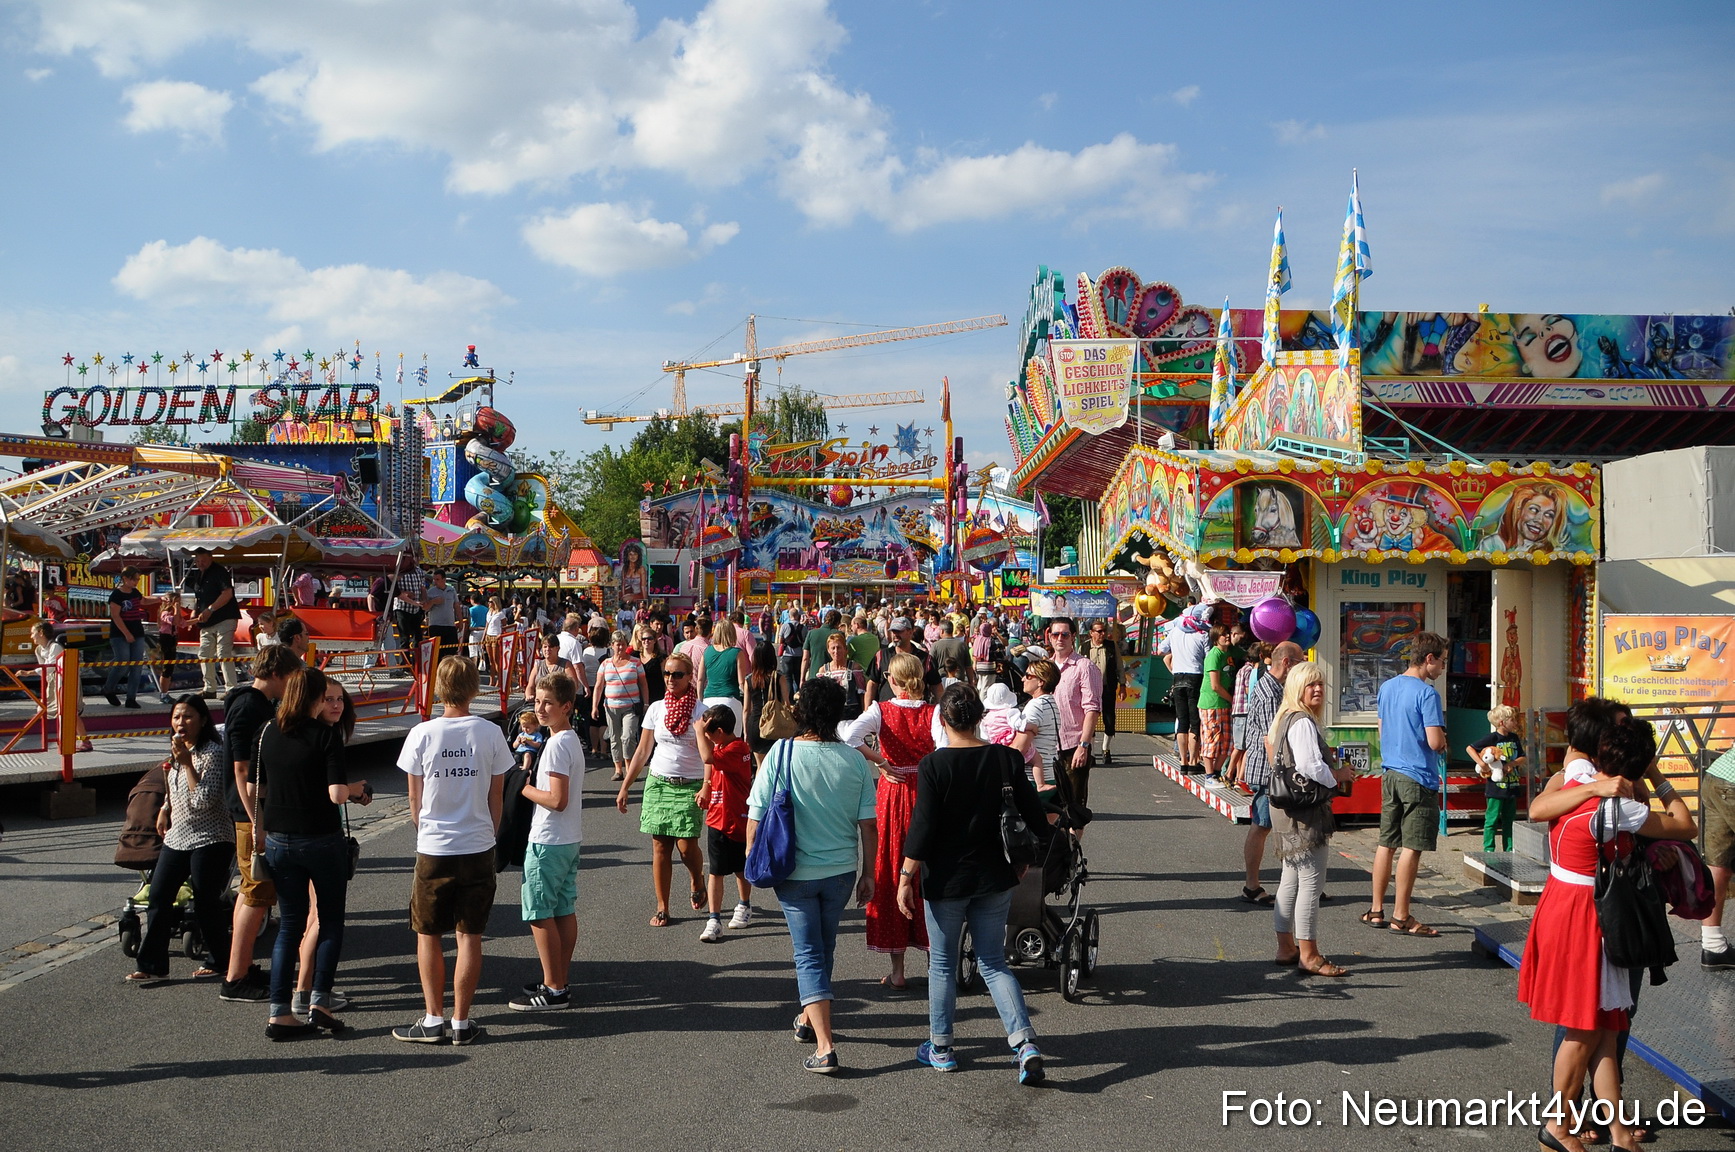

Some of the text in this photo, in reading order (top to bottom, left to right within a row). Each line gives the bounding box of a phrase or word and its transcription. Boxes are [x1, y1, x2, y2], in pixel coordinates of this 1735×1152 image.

[1084, 348, 1107, 360] DAS
[1065, 363, 1127, 379] GESCHICK-
[1063, 379, 1129, 397] LICHKEITS-
[42, 383, 380, 427] GOLDEN STAR
[1081, 396, 1114, 410] SPIEL
[1341, 569, 1428, 588] King Play
[1213, 577, 1277, 595] Knack den Jackpot
[1614, 626, 1727, 659] King Play
[1613, 675, 1728, 688] Das Geschicklichkeitsspiel
[1623, 686, 1634, 695] für
[1636, 687, 1649, 695] die
[1651, 689, 1677, 698] ganze
[1679, 688, 1711, 697] Familie
[441, 748, 467, 758] doch
[445, 767, 479, 778] 1433er
[1667, 762, 1689, 771] Spaß
